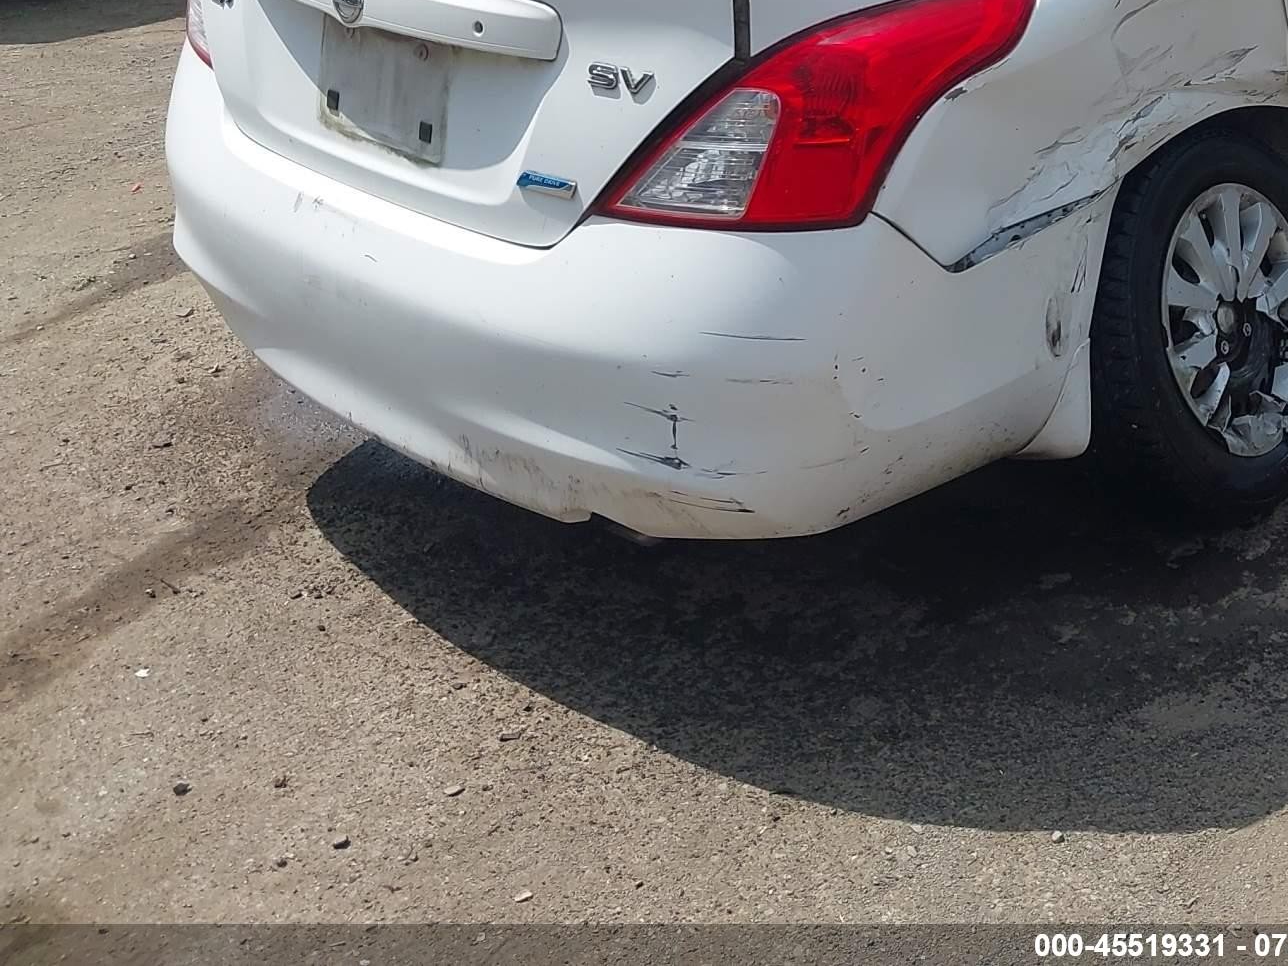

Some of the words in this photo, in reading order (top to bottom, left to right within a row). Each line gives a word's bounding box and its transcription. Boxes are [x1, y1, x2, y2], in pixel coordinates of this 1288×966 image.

[587, 62, 655, 94] SV
[529, 175, 543, 183] PURE
[544, 178, 561, 187] DRIVE
